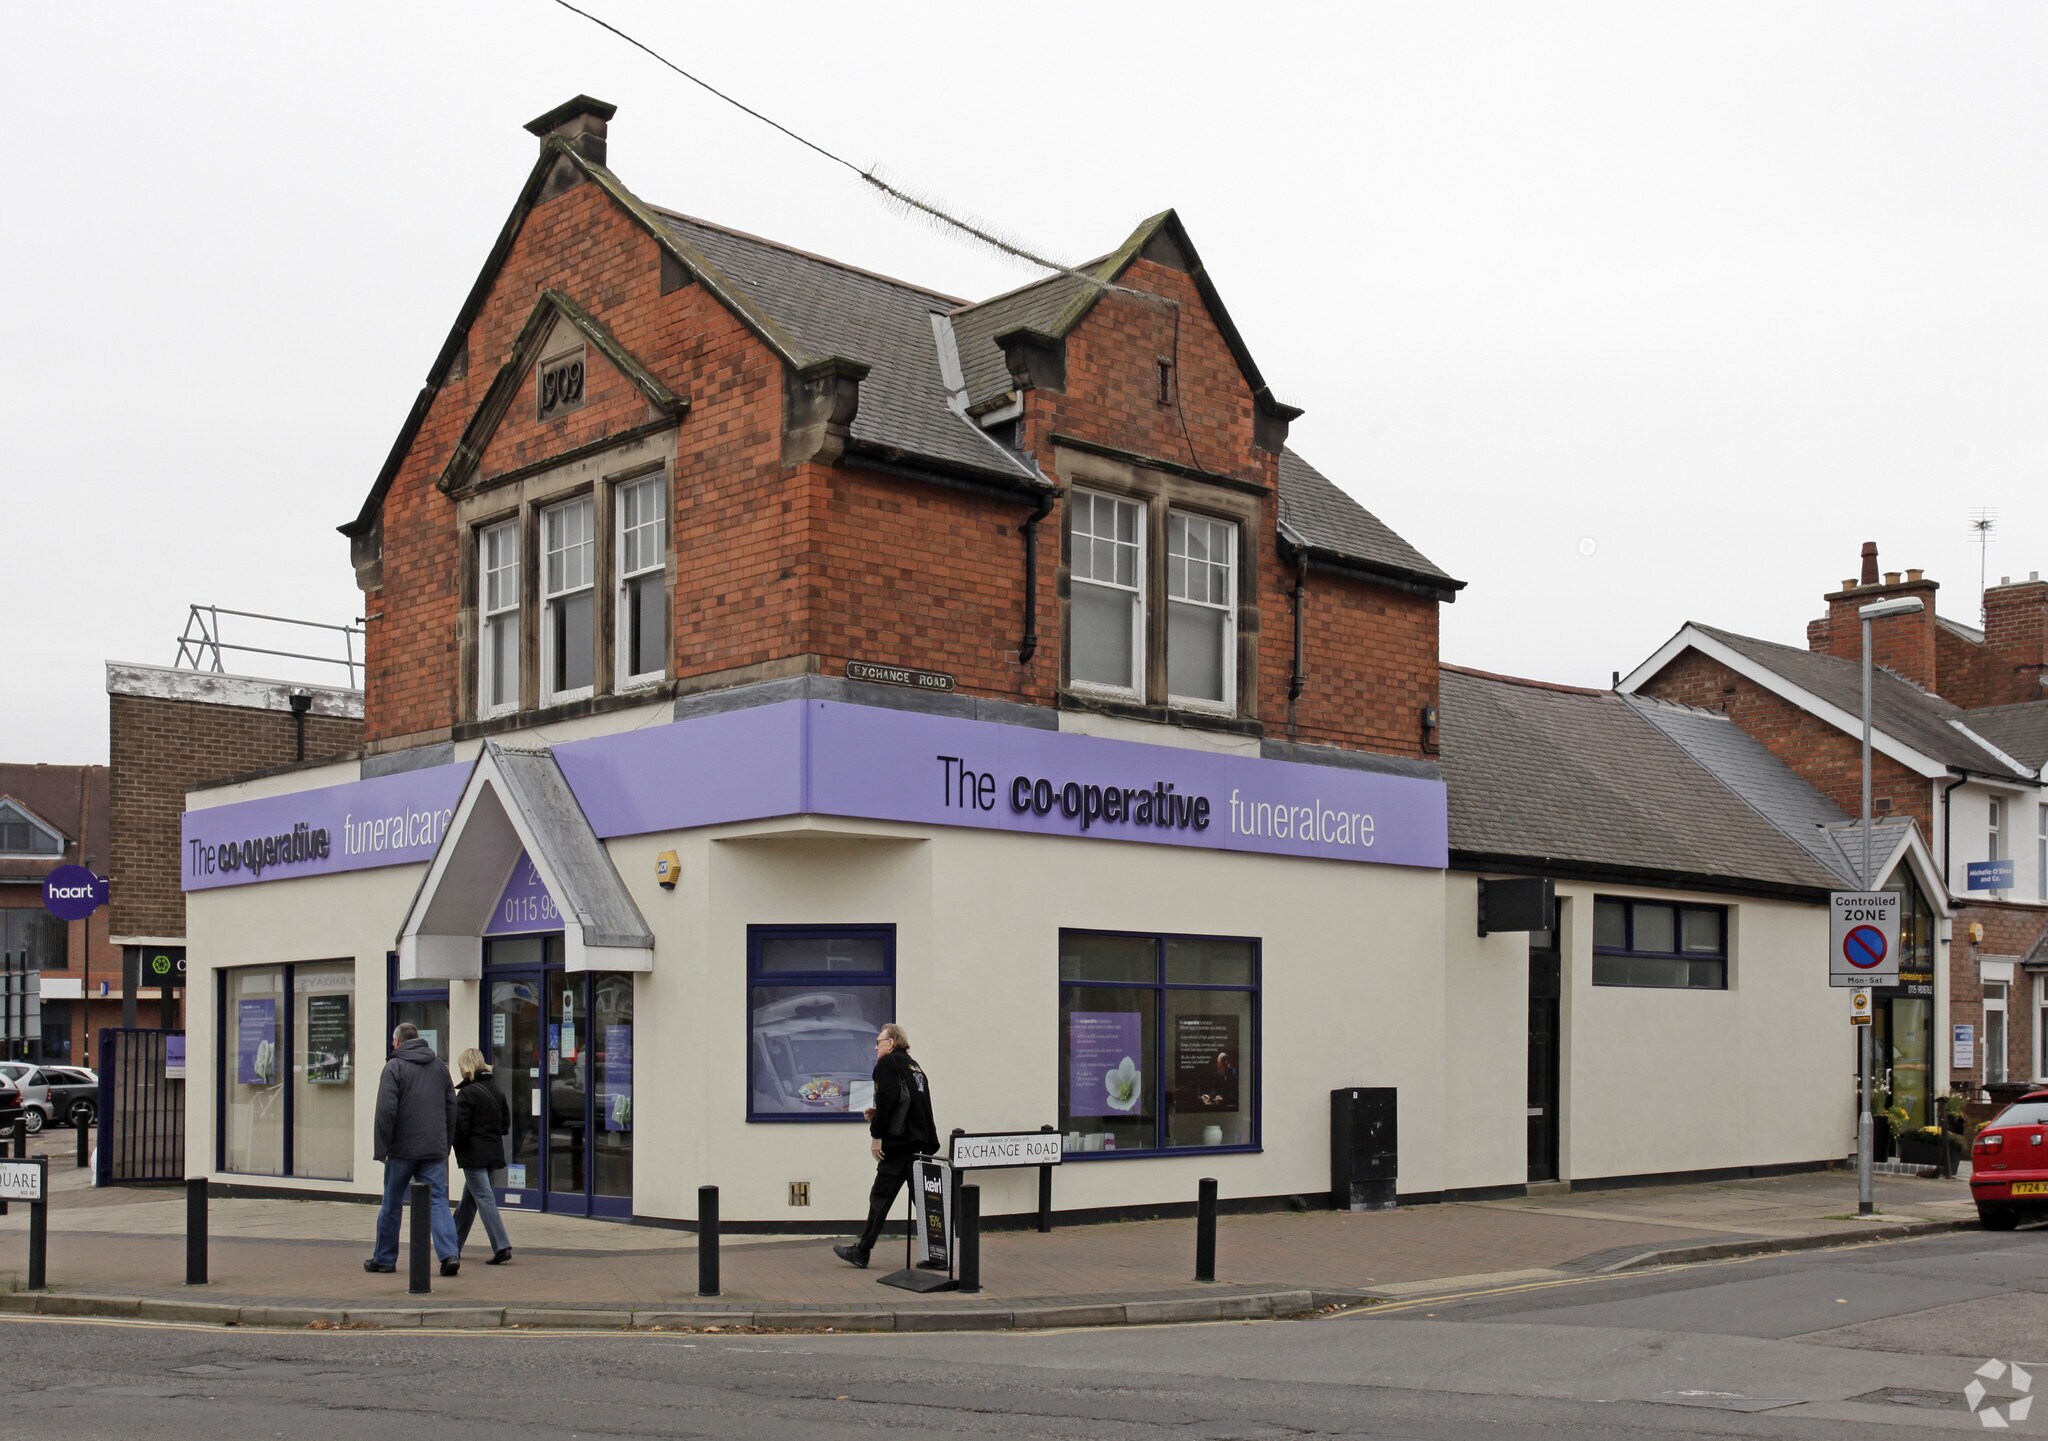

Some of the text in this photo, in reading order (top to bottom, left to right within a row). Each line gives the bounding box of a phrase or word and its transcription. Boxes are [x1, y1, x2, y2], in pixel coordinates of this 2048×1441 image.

[854, 664, 910, 683] EXCHANGE
[936, 755, 996, 811] The
[1229, 788, 1376, 847] funeralcare
[189, 838, 216, 876] The
[49, 883, 93, 899] haart
[505, 896, 537, 923] 0115
[1835, 896, 1896, 906] Controlled
[1844, 909, 1887, 921] ZONE
[957, 1142, 1059, 1159] EXCHANGE ROAD
[2016, 1183, 2040, 1193] Y724
